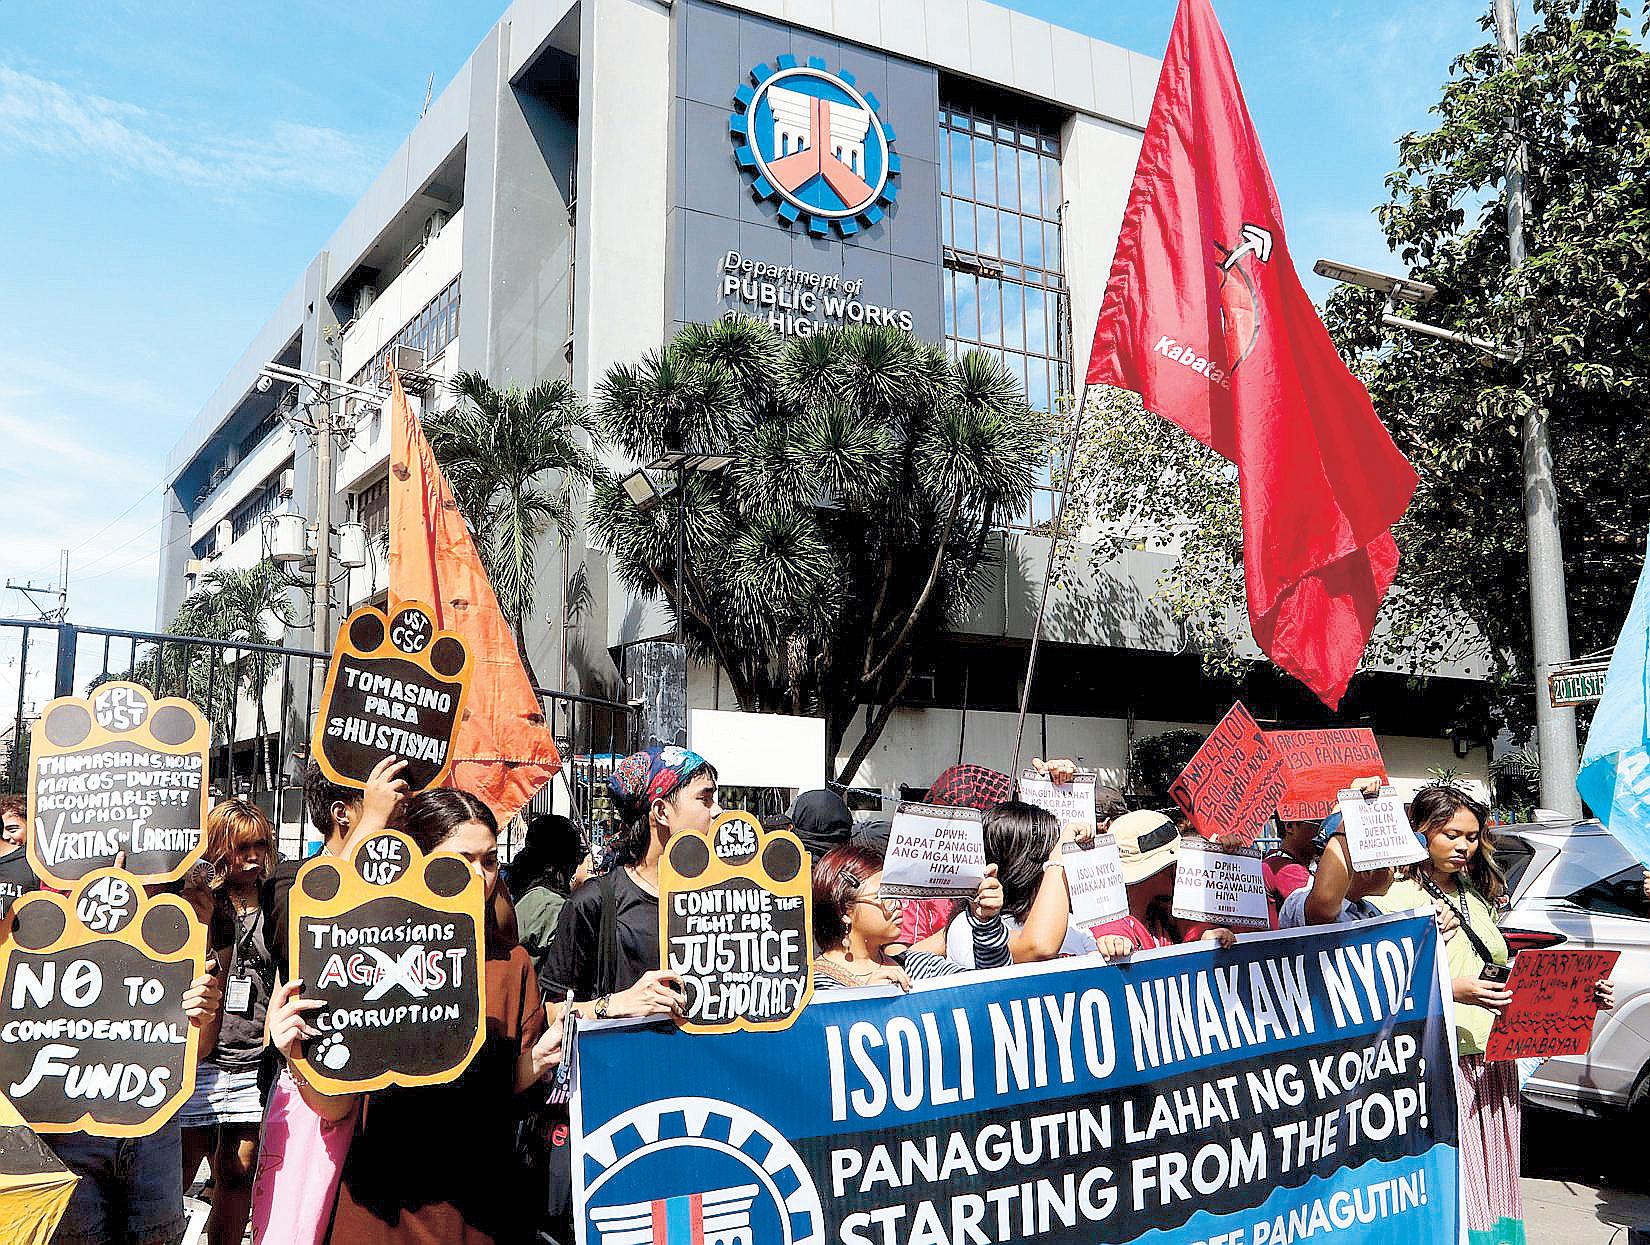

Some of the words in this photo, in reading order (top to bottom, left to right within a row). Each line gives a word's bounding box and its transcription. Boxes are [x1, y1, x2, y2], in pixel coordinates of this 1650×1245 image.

[724, 250, 840, 291] Department
[844, 278, 863, 295] of
[724, 275, 817, 312] PUBLIC
[824, 295, 913, 331] WORKS
[404, 611, 428, 631] UST
[392, 626, 425, 652] CSC
[344, 667, 451, 713] TOMASINO
[96, 706, 144, 730] UST
[364, 696, 419, 724] PARA
[342, 716, 447, 765] HUSTISYA!
[70, 805, 153, 824] UPHOLD
[1061, 809, 1085, 818] FROM
[896, 835, 935, 849] DAPAT
[934, 828, 968, 840] DPWH:
[892, 846, 919, 859] ANG
[922, 851, 948, 863] MGA
[363, 861, 402, 885] UST
[929, 863, 960, 875] HIYA!
[1176, 876, 1202, 887] ANG
[1178, 866, 1216, 879] DAPAT
[87, 877, 129, 907] AB
[673, 889, 772, 916] CONTINUE
[774, 897, 803, 911] THE
[1215, 891, 1239, 901] HIYA!
[76, 898, 128, 932] UST
[686, 914, 736, 934] FIGHT
[741, 913, 774, 932] FOR
[307, 918, 455, 949] Thomasians
[669, 929, 800, 975] JUSTICE
[317, 947, 467, 990] AGANST
[123, 976, 164, 1007] TO
[682, 974, 806, 1020] DEMOCRACY
[0, 1018, 188, 1043] CONFIDENTIAL
[316, 1004, 460, 1031] CORRUPTION
[824, 1007, 975, 1122] ISOLI
[988, 988, 1117, 1094] NIYO
[1124, 955, 1316, 1072] NINAKAW
[1317, 936, 1415, 1029] NYO!
[10, 1043, 171, 1108] FUNDS
[831, 1105, 1111, 1197] PANAGUTIN
[1123, 1075, 1241, 1144] LAHAT
[1245, 1063, 1306, 1115] NG
[1308, 1034, 1426, 1099] KORAP,
[839, 1170, 1118, 1245] STARTING
[1132, 1138, 1267, 1212] FROM
[1272, 1109, 1347, 1173] THE
[1344, 1083, 1429, 1147] TOP!
[1252, 1168, 1428, 1245] PANAGUTIN!
